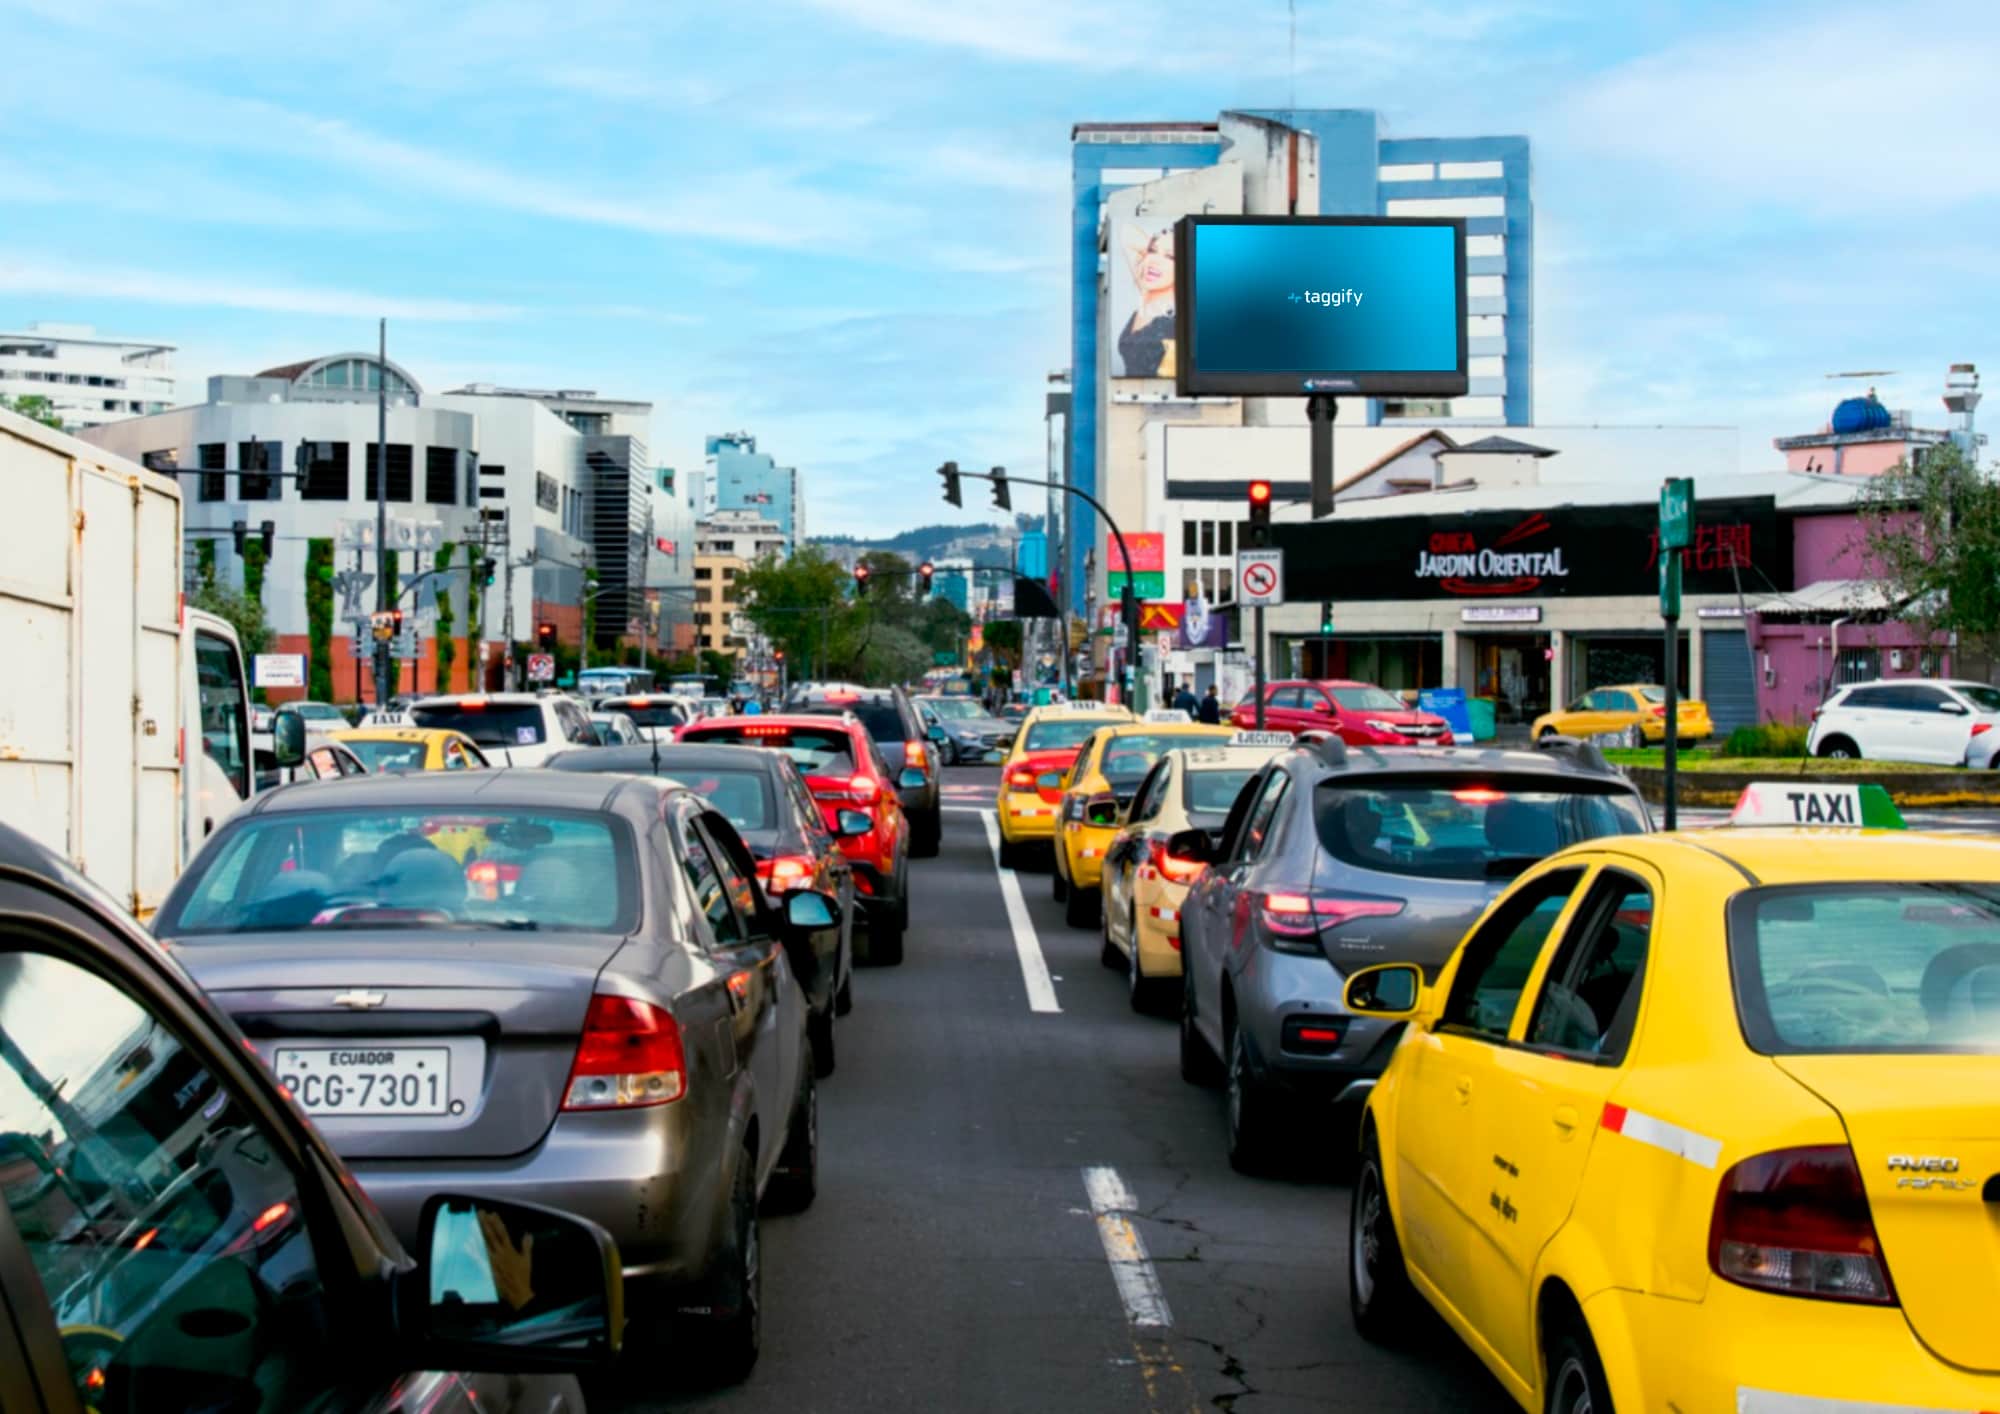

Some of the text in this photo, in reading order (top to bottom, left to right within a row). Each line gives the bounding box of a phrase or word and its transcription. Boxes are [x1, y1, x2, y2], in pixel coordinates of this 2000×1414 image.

[1304, 288, 1364, 307] taggify
[1415, 547, 1569, 577] JARDIN ORIENTAL
[372, 714, 402, 724] TAXI
[1237, 732, 1292, 745] EJECUTIVO
[1787, 792, 1854, 824] TAXI
[329, 1052, 395, 1066] ECUADOR
[280, 1074, 438, 1107] PCG-7301
[1887, 1155, 1959, 1173] AVEO
